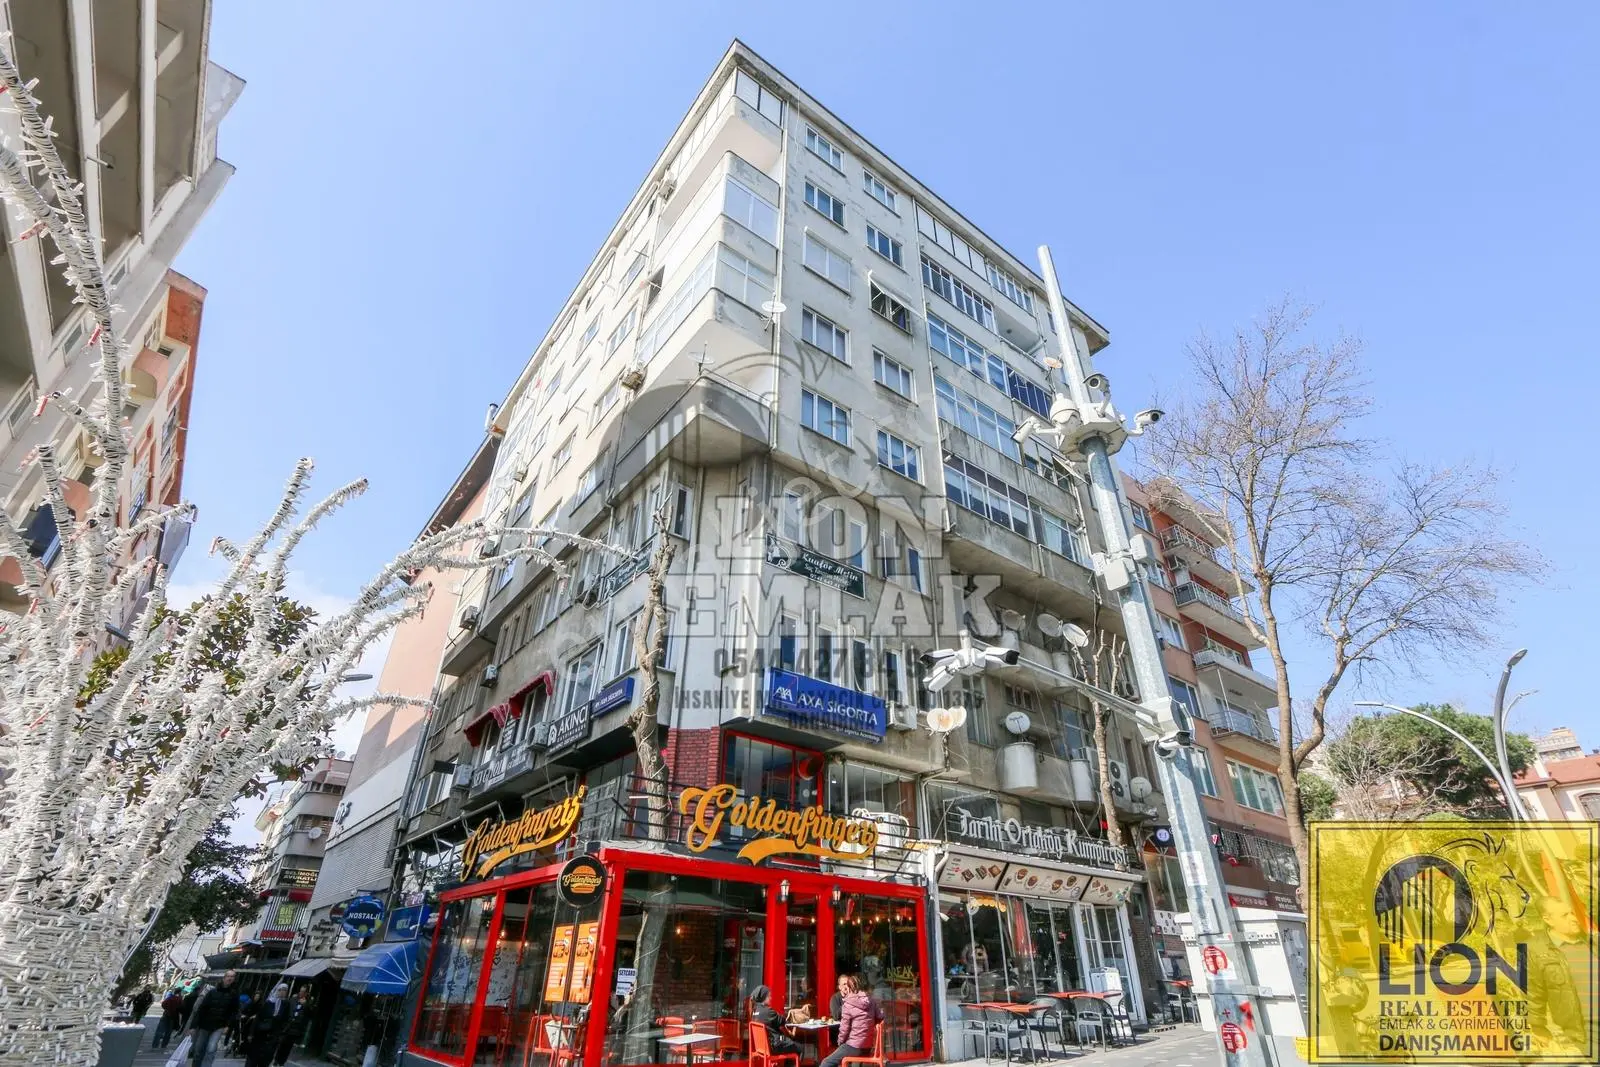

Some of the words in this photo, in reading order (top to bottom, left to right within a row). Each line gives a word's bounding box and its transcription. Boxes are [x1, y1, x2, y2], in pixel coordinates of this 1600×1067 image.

[773, 686, 793, 702] AXA
[797, 693, 824, 711] AXA
[558, 704, 588, 737] AKINCI
[679, 784, 879, 854] Goldenfingers
